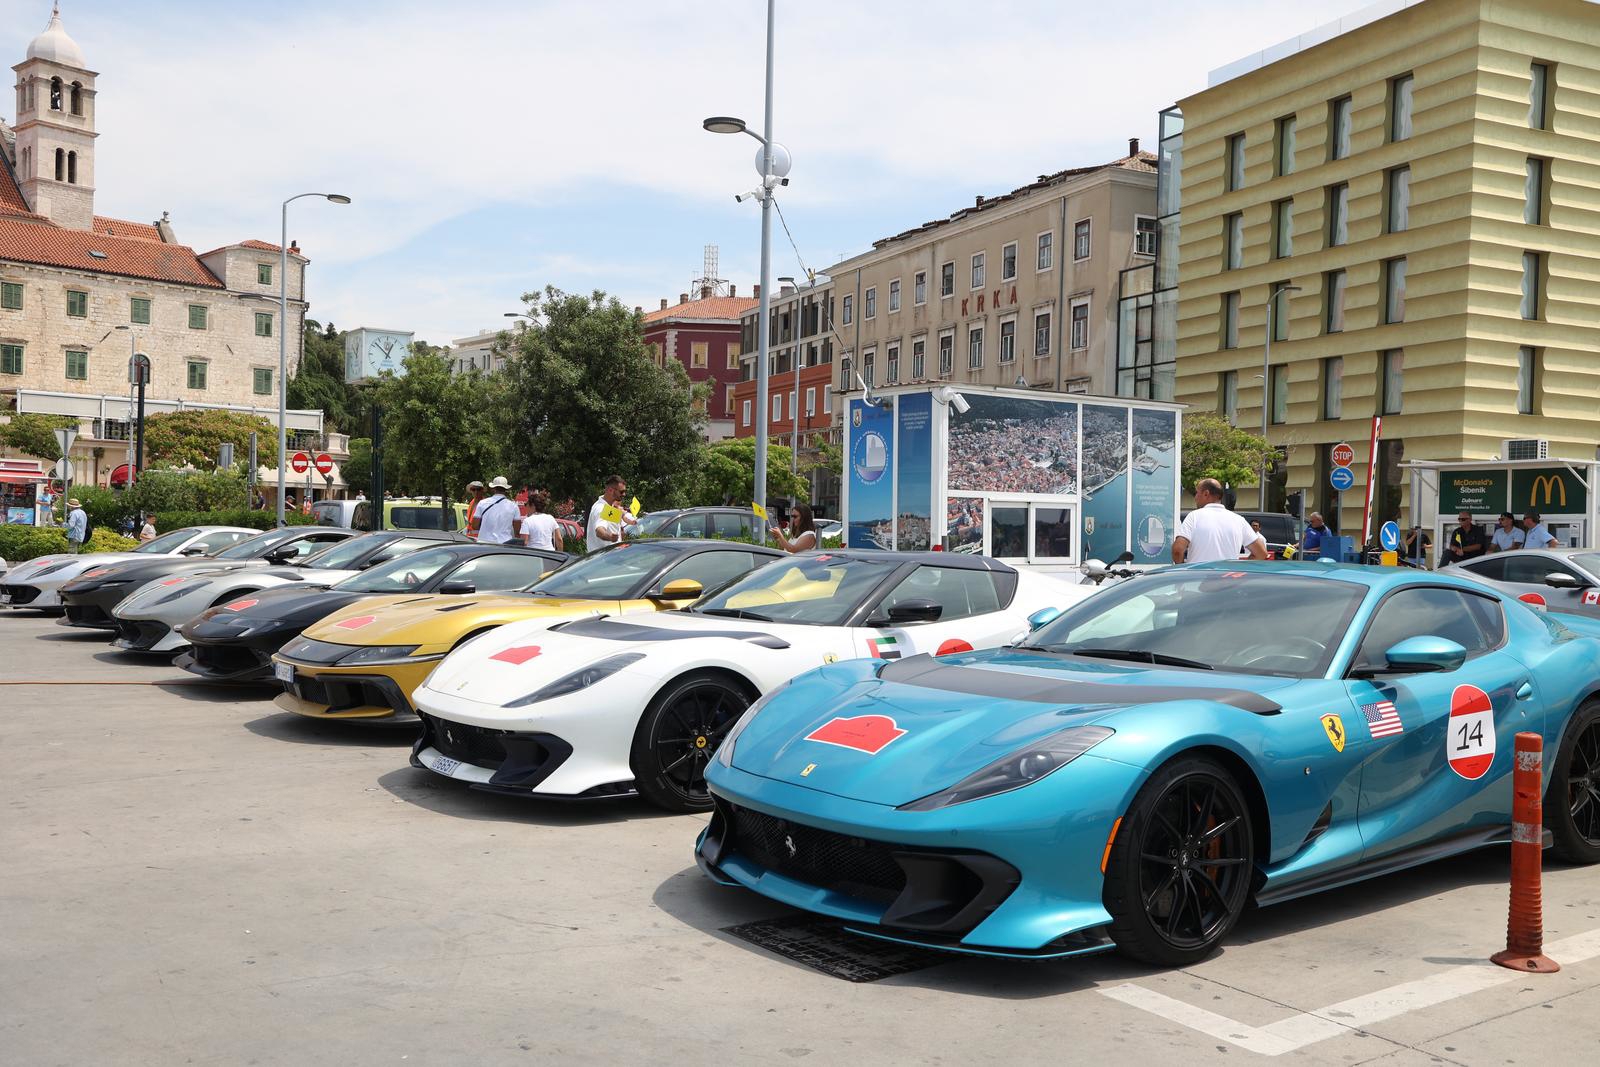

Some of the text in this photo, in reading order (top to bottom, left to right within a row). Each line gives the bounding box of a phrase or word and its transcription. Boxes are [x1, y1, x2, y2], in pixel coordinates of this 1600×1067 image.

[961, 286, 1018, 317] KRKA
[1334, 451, 1352, 460] STOP
[1460, 486, 1486, 494] Šibenik
[1456, 719, 1484, 751] 14
